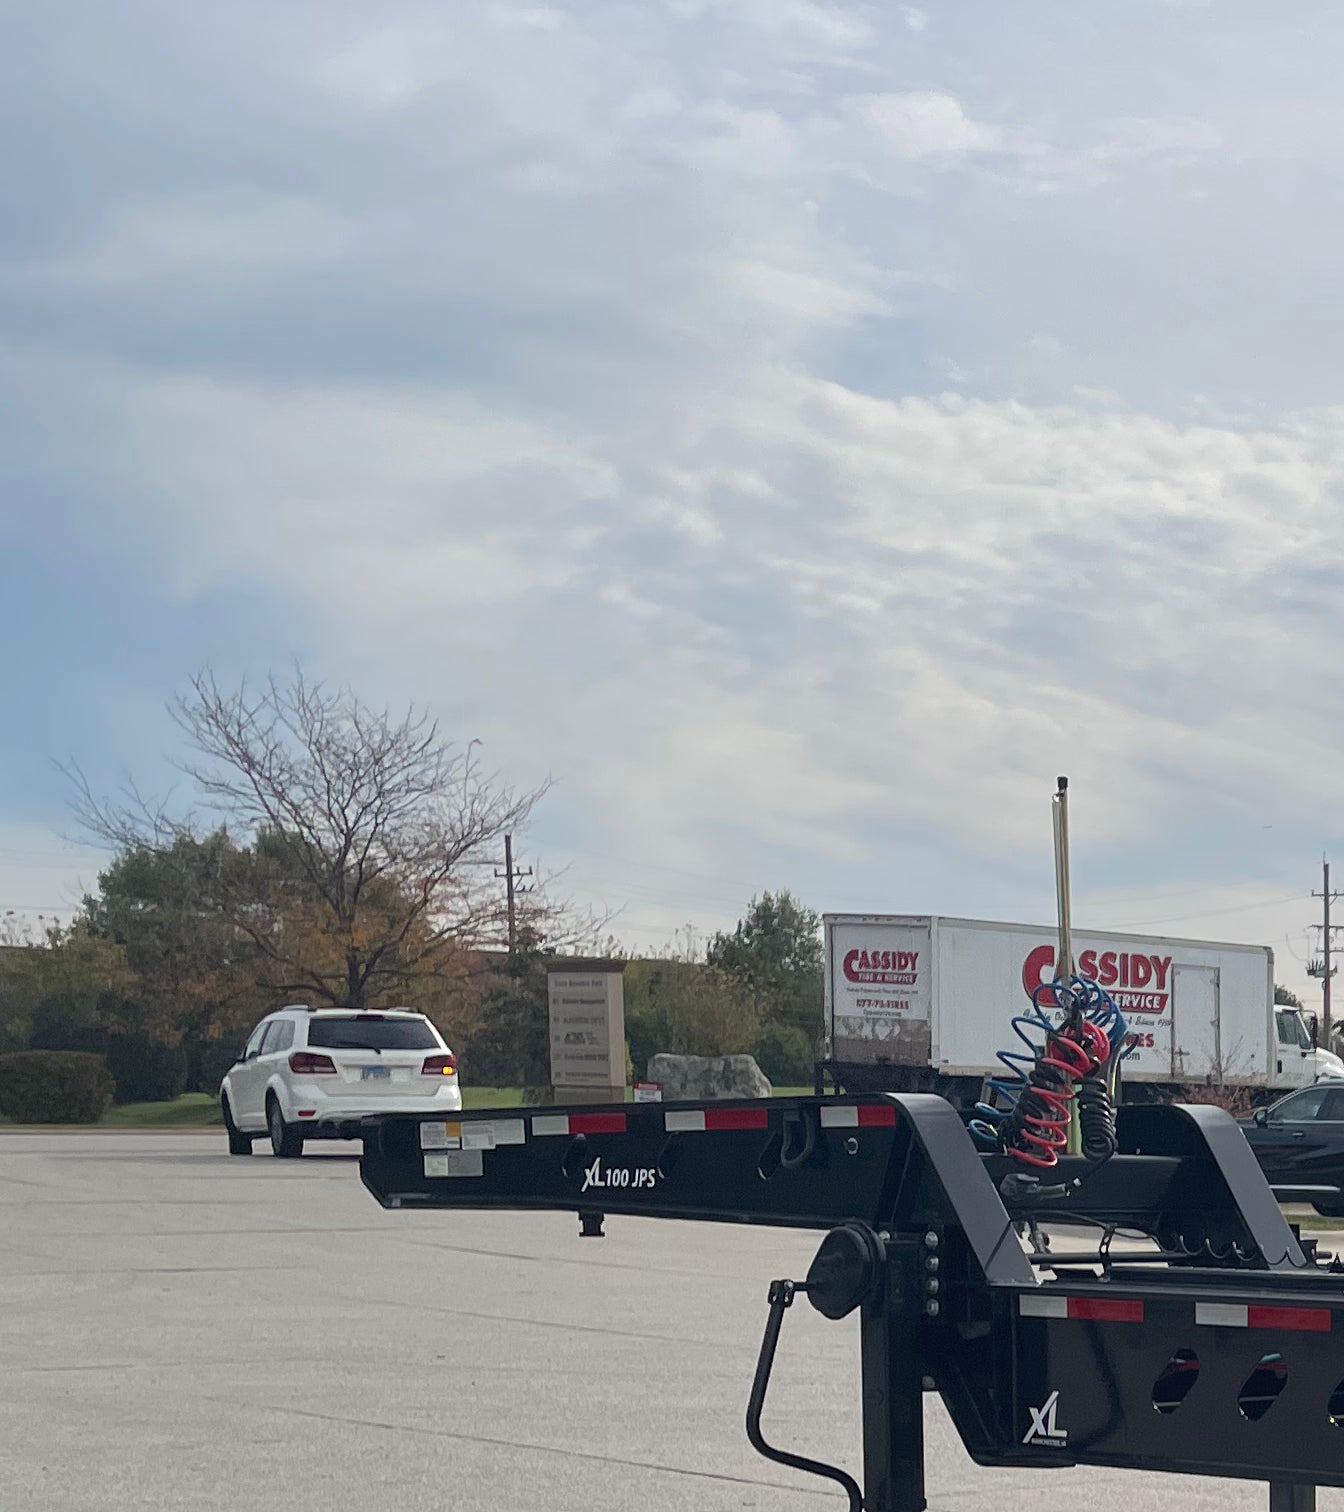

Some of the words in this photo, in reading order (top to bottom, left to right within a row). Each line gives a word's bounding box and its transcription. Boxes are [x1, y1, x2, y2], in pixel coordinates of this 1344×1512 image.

[843, 949, 919, 983] CASSIDY
[631, 1168, 656, 1188] JPS
[1022, 1390, 1067, 1444] XL
